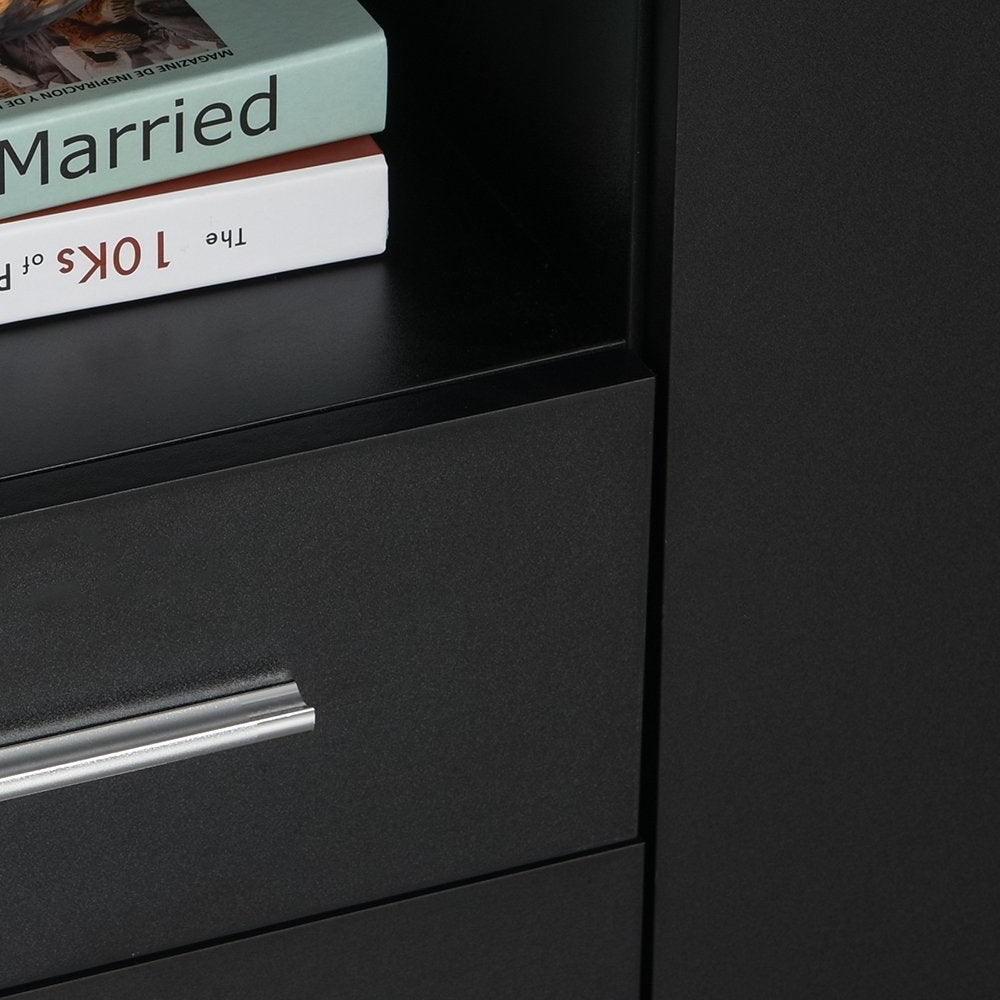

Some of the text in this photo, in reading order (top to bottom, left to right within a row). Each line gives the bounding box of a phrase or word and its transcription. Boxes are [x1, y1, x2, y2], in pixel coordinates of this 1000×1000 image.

[160, 49, 235, 73] MAGAZINE
[134, 68, 155, 79] DE
[39, 73, 134, 100] INSPIRACION
[7, 98, 27, 109] DE
[29, 94, 39, 104] Y
[205, 227, 247, 248] The
[22, 252, 45, 275] of
